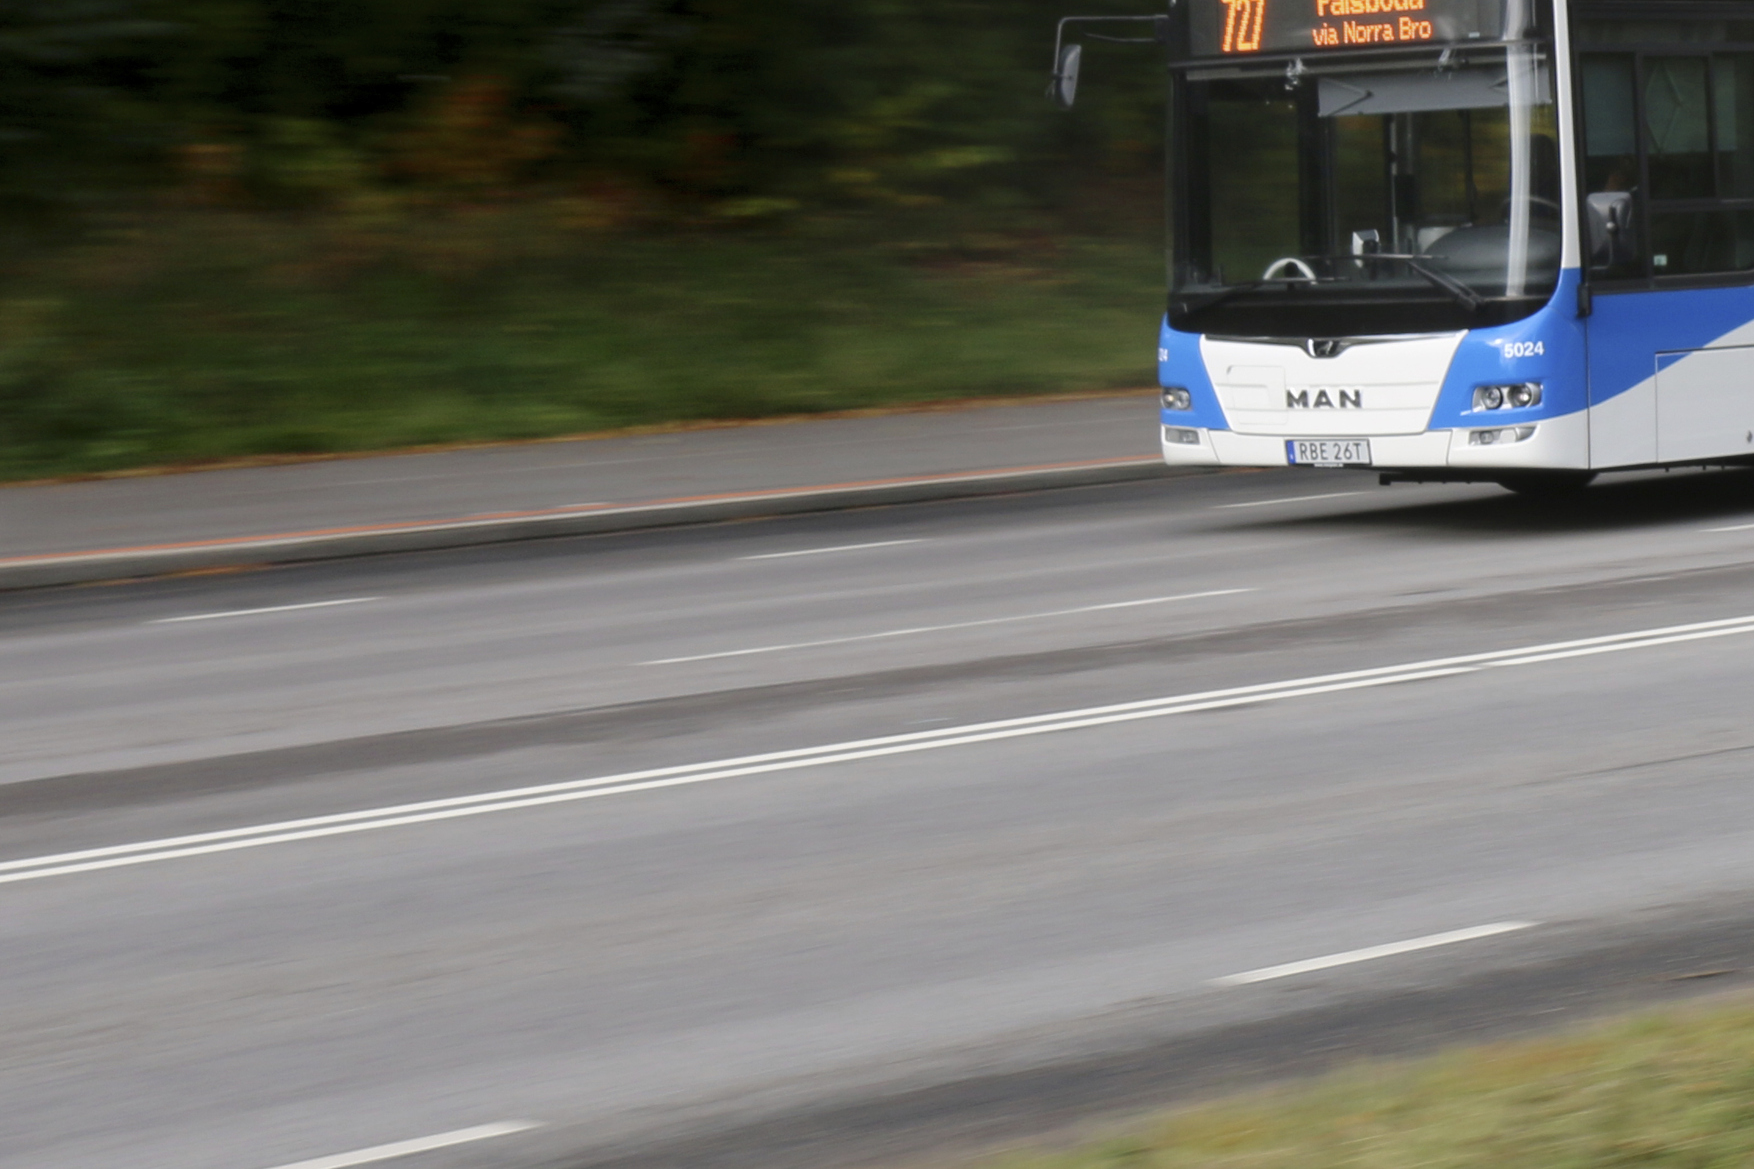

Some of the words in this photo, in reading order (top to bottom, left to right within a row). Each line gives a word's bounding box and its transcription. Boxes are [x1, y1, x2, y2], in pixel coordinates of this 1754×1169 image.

[1311, 22, 1340, 46] via
[1343, 20, 1395, 44] Norra
[1398, 16, 1432, 40] Bro
[1504, 341, 1545, 359] 5024
[1286, 389, 1362, 409] MAN
[1299, 442, 1329, 461] RBE
[1333, 442, 1362, 461] 26T
